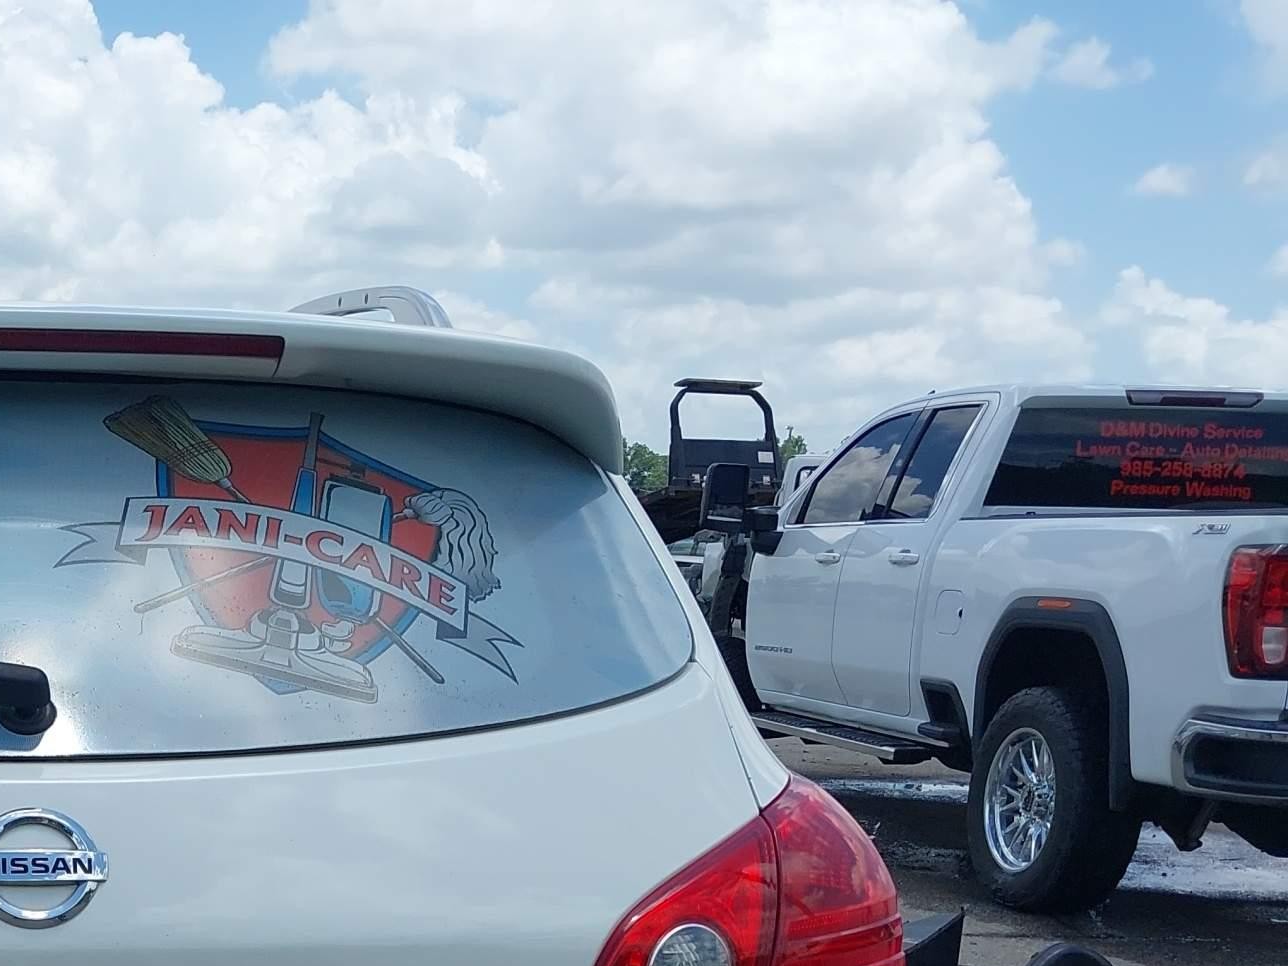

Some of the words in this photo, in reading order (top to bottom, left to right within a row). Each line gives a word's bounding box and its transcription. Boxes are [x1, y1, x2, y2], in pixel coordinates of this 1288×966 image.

[1149, 422, 1198, 439] Divine
[1204, 423, 1264, 439] Service
[1076, 440, 1121, 457] Lawn
[1126, 441, 1165, 458] Care
[1180, 442, 1221, 458] Auto
[1110, 479, 1180, 496] Pressure
[1185, 481, 1252, 500] Washing
[136, 503, 458, 617] JANI-CARE
